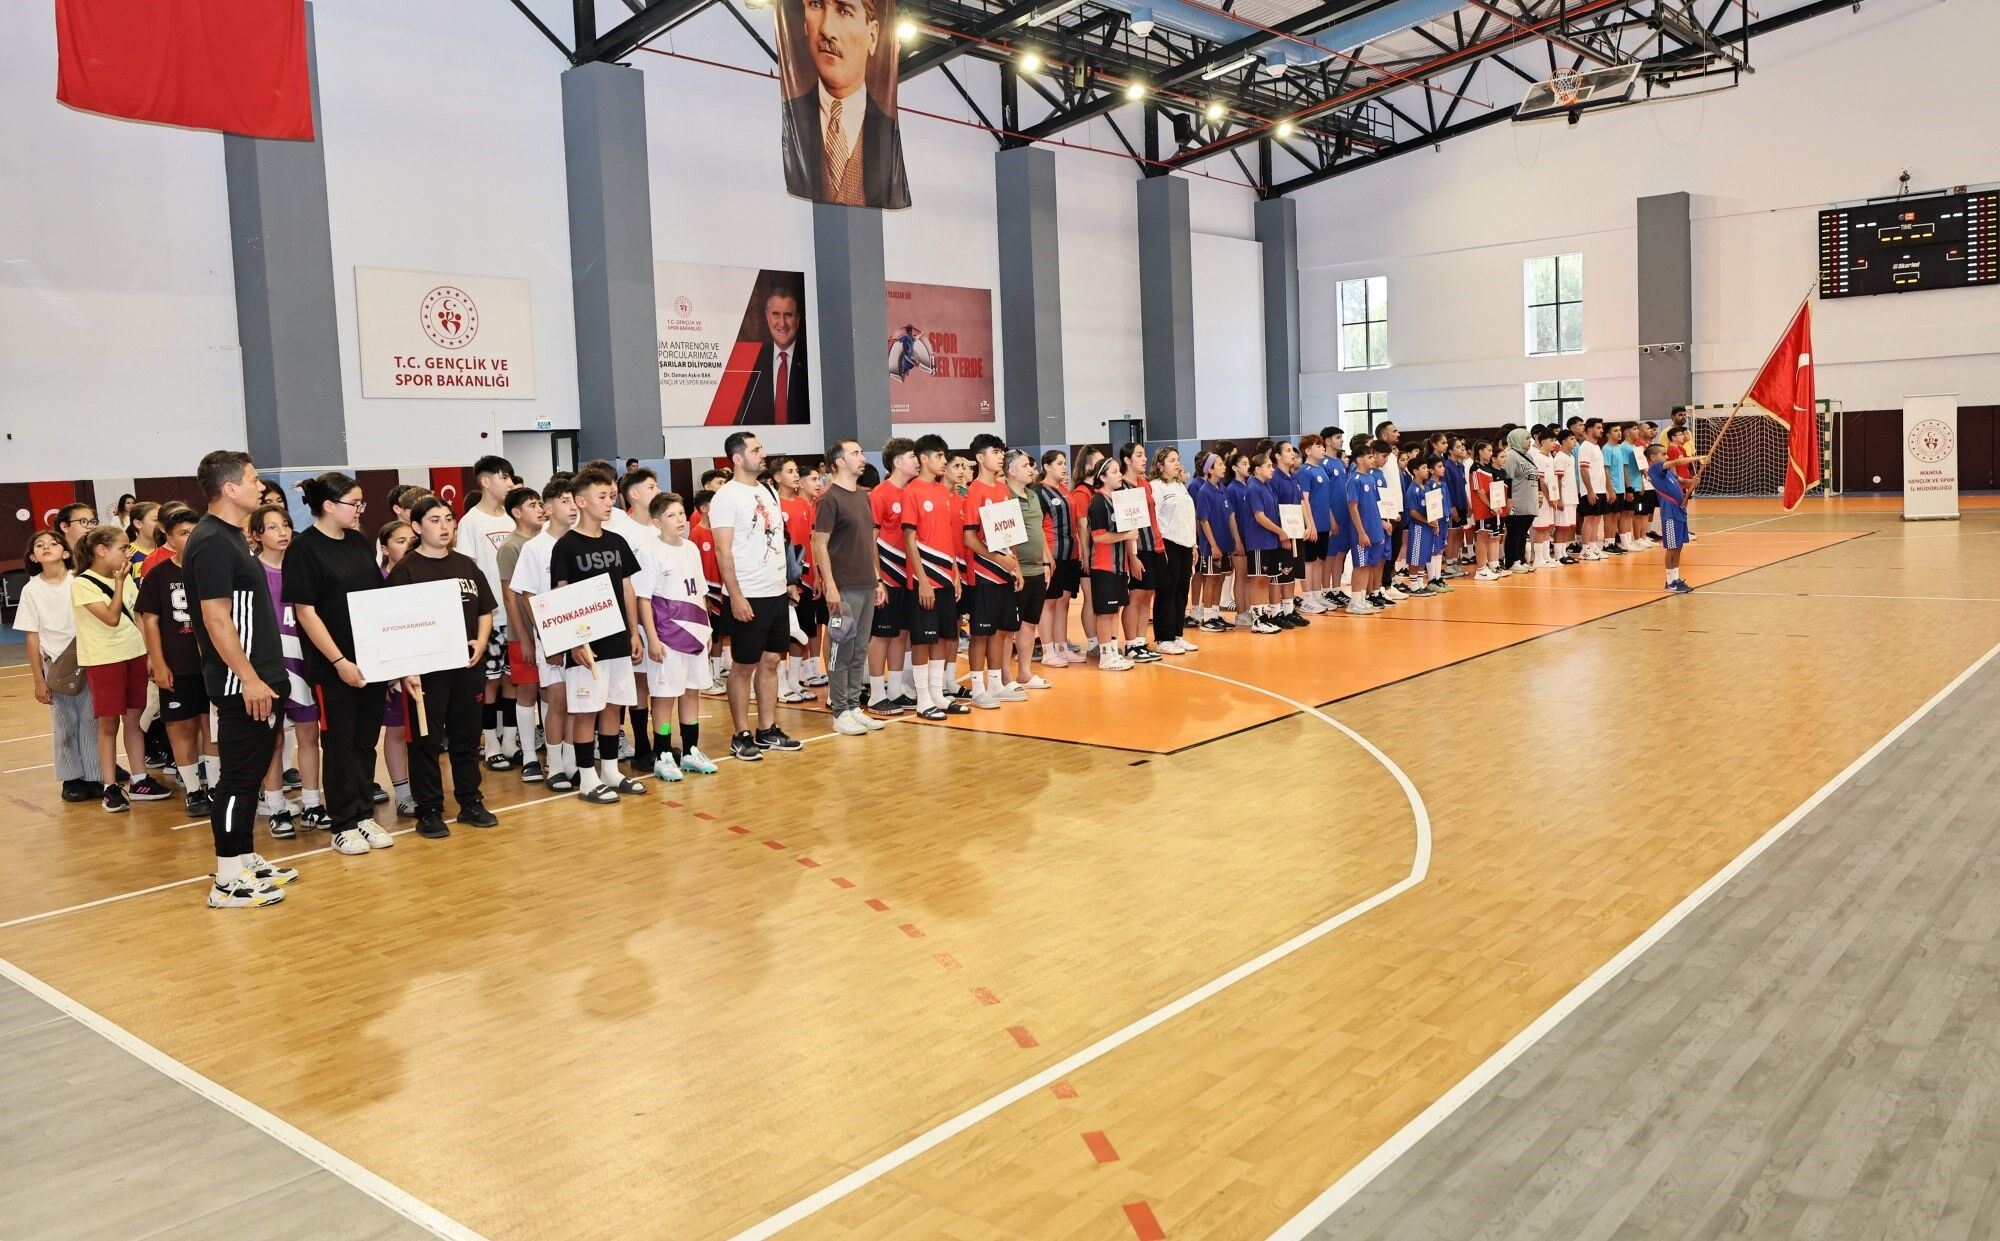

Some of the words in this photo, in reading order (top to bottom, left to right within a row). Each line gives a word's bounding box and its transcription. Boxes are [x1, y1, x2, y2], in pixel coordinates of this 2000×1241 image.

[670, 341, 709, 350] ANTRENÖR
[710, 342, 720, 350] VE
[929, 331, 958, 354] SPOR
[394, 356, 421, 369] T.C.
[425, 355, 487, 373] GENÇLİK
[491, 359, 508, 370] VE
[658, 351, 718, 359] PORCULARIMIZA
[952, 357, 984, 379] YERDE
[395, 373, 432, 386] SPOR
[437, 373, 509, 388] BAKANLIĞI
[994, 519, 1016, 533] AYDIN
[684, 578, 698, 596] 14
[283, 606, 296, 627] 4
[541, 599, 614, 630] AFYONKARAHİSAR
